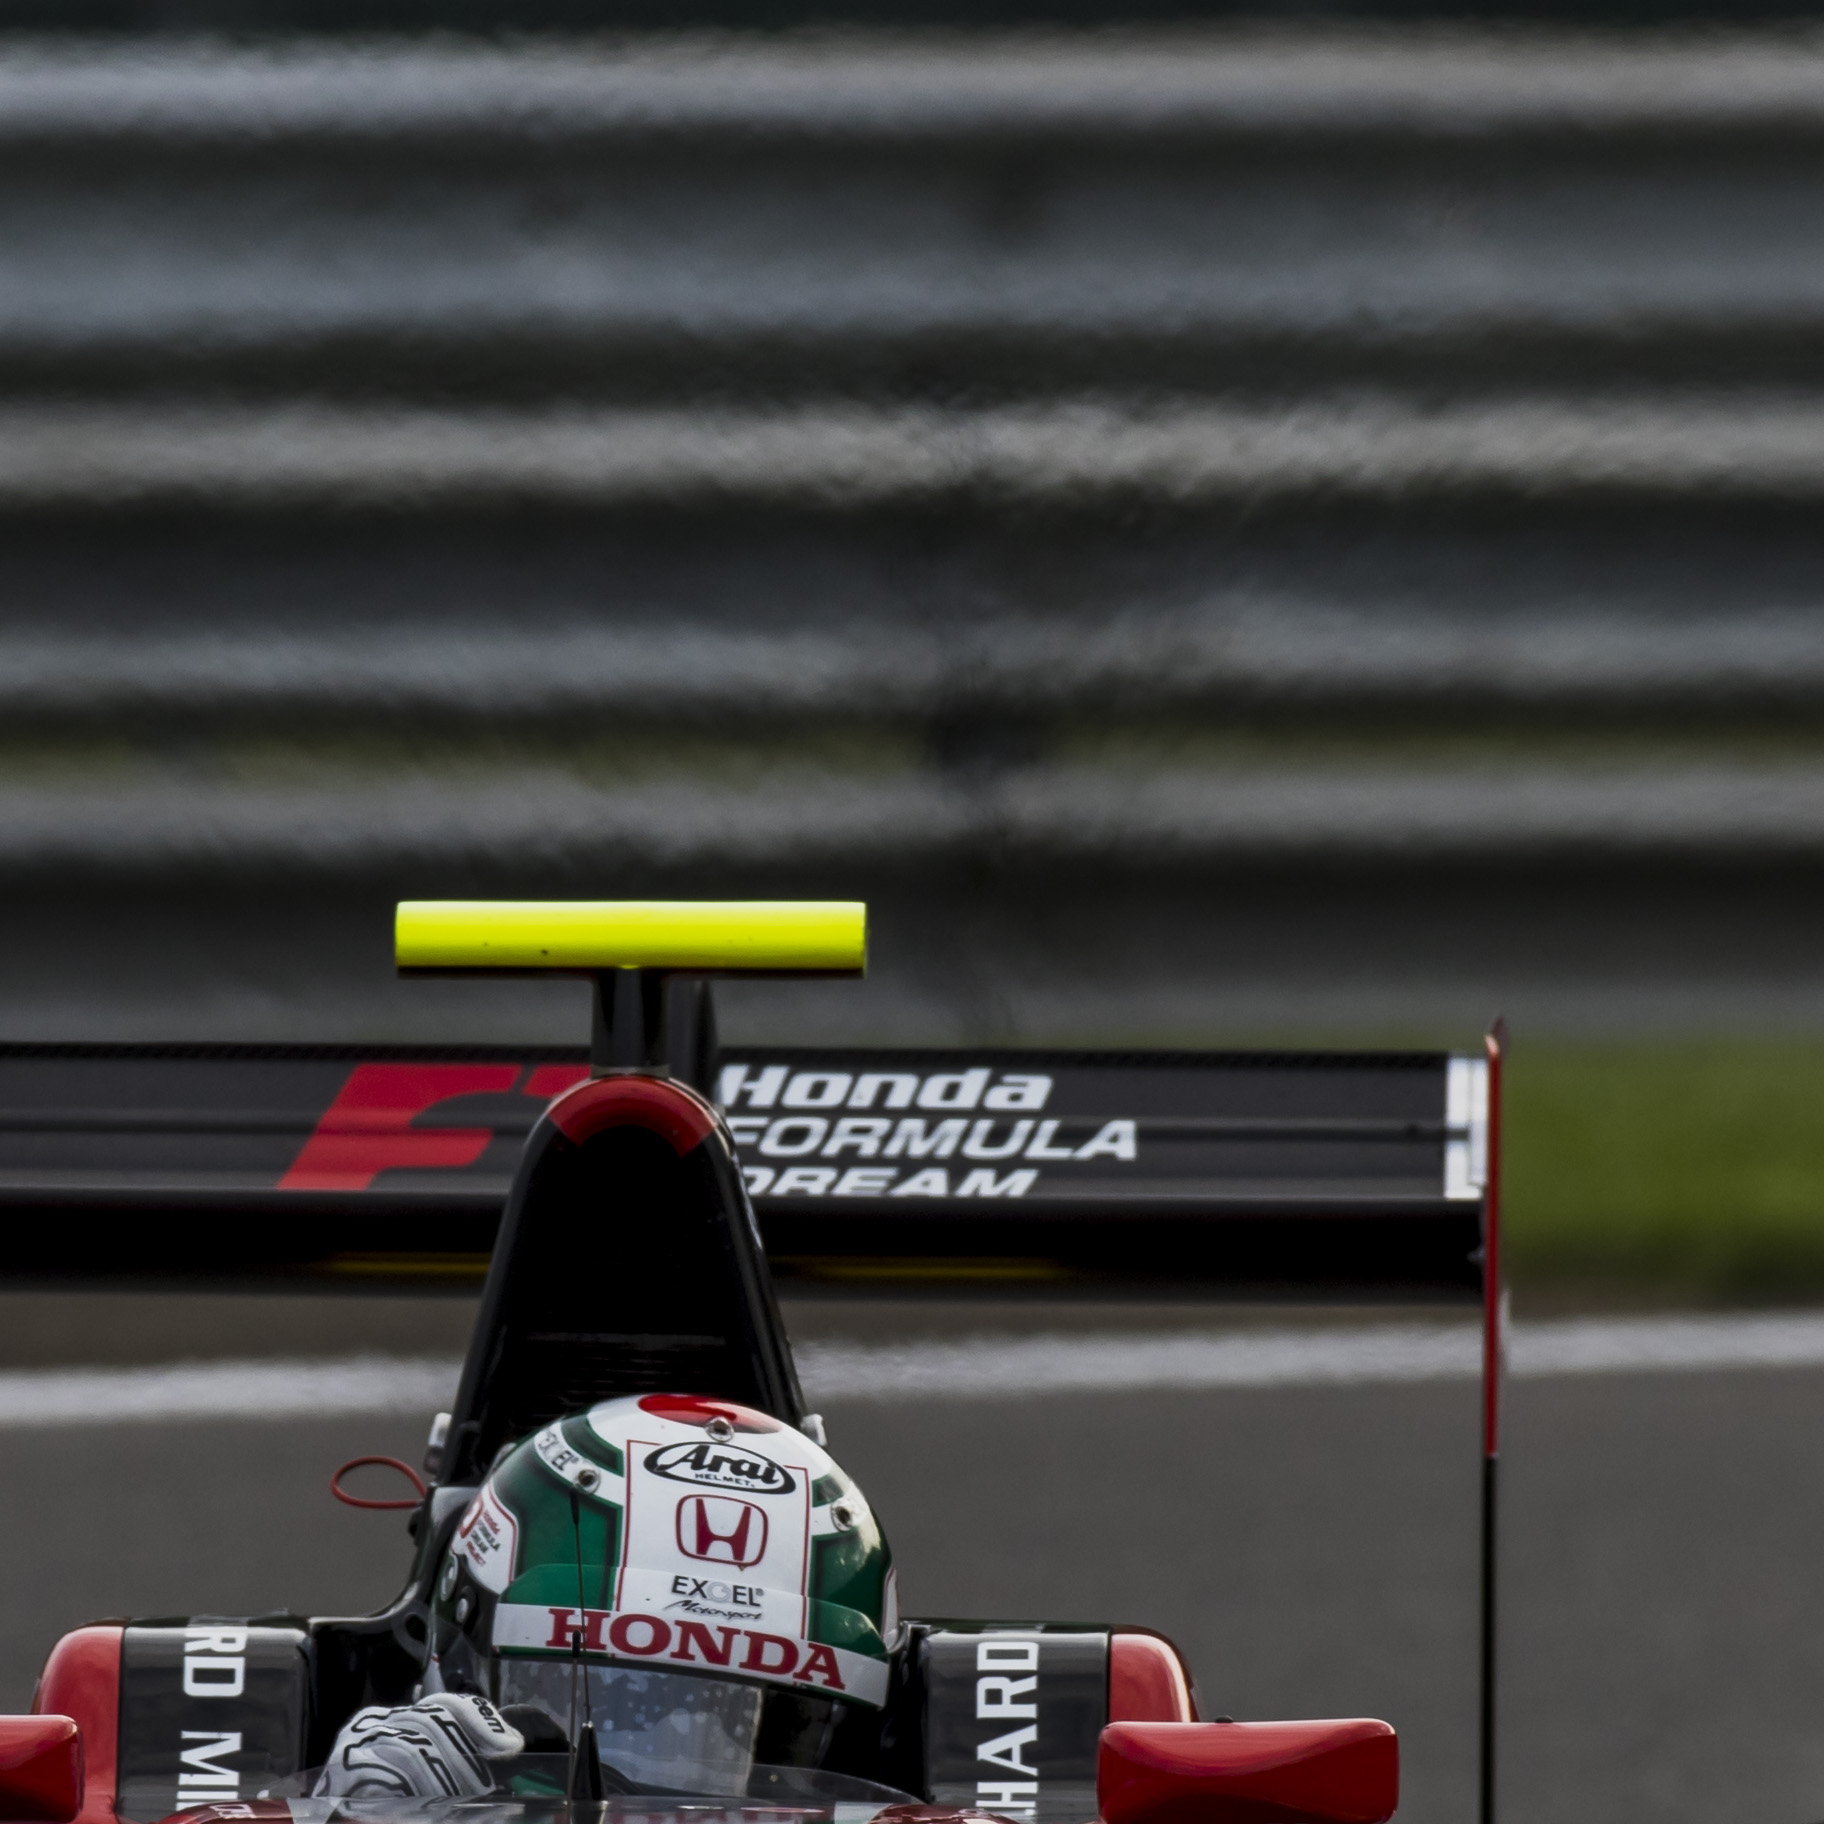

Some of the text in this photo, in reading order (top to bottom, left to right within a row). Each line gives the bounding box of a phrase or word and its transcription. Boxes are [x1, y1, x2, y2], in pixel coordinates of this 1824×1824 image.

[719, 1064, 1054, 1111] Honda
[724, 1115, 1137, 1160] FORMULA
[654, 1444, 779, 1484] Arai
[546, 1607, 846, 1691] HONDA
[975, 1641, 1039, 1820] HARD
